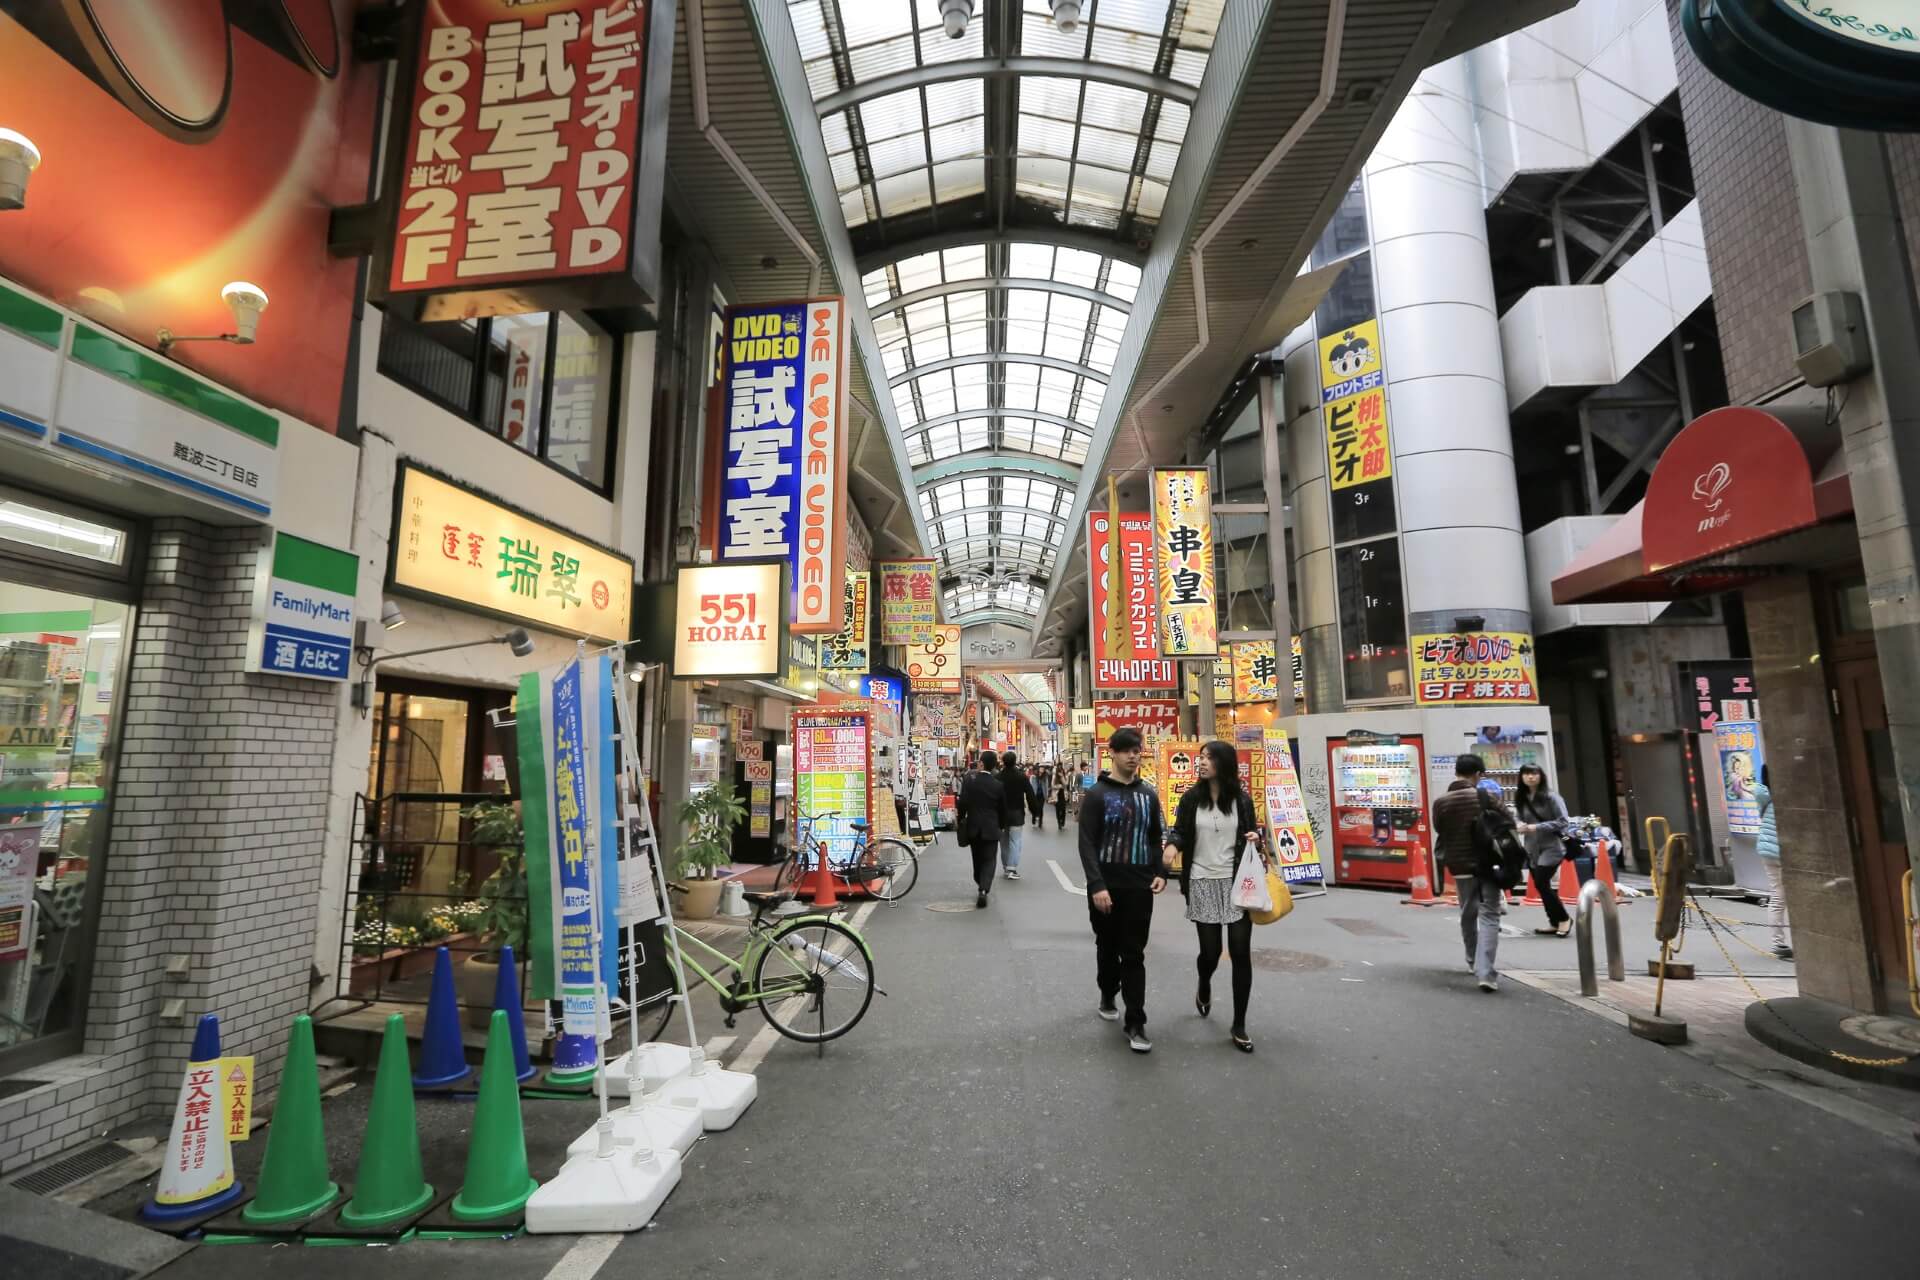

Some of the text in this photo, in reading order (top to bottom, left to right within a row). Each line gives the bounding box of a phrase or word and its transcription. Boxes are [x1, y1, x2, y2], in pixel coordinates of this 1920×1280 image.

[399, 26, 473, 283] BOOK 当ビル 2F
[456, 11, 581, 279] 試写室
[731, 336, 801, 364] VIDEO
[733, 313, 782, 340] DVD
[811, 308, 832, 362] WE
[1330, 400, 1362, 483] ビデオ
[1358, 393, 1386, 478] 桃太郎
[173, 441, 260, 488] 難波三丁目店
[723, 365, 797, 559] 試写室
[1354, 492, 1370, 505] 3F
[496, 535, 582, 610] 瑞翠
[1167, 524, 1209, 606] 串皇
[1359, 548, 1375, 561] 2F
[272, 591, 350, 622] FamilyMart
[700, 592, 756, 625] 551
[884, 572, 934, 602] 麻雀
[1129, 541, 1148, 649] コミックカフェ
[1365, 595, 1379, 608] 1F
[273, 640, 341, 672] 酒 たばこ
[687, 624, 767, 642] HORAI
[1096, 704, 1177, 718] ネットカフェ
[7, 727, 57, 744] ATM
[1251, 752, 1266, 825] フリータイム
[182, 1069, 214, 1134] 立入禁止
[229, 1084, 248, 1136] 立入禁止
